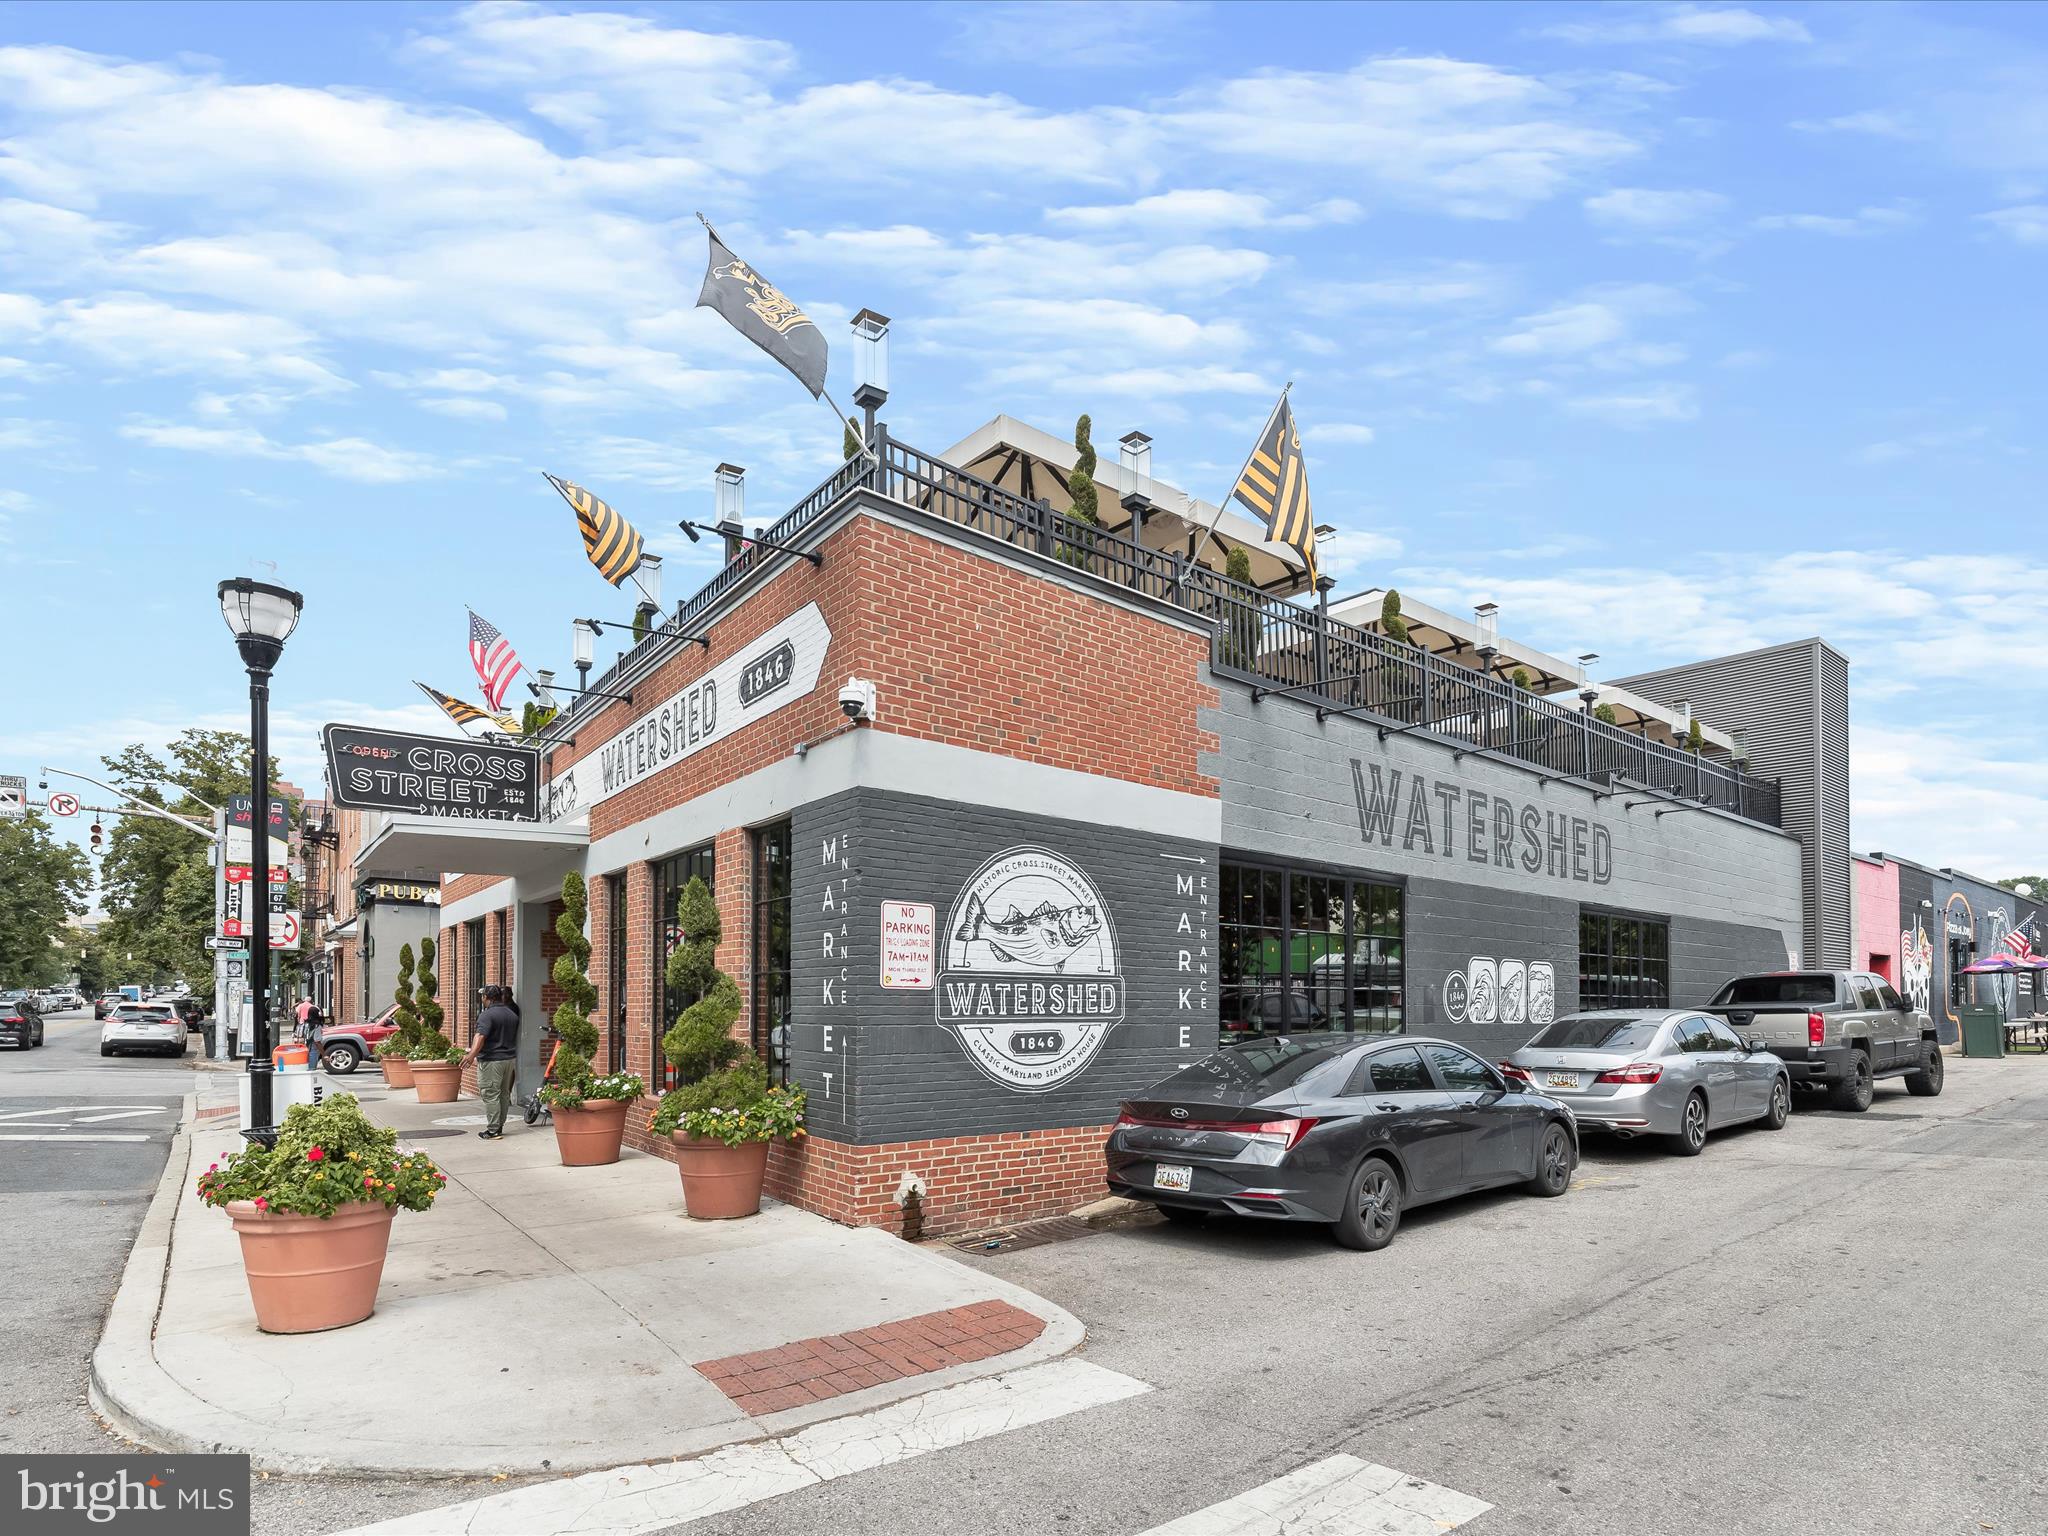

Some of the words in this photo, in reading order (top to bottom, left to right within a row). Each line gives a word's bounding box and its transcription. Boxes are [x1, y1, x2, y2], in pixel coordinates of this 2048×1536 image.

[748, 654, 784, 695] 1846
[601, 678, 717, 793] WATERSHED
[408, 746, 526, 782] CROSS
[350, 768, 493, 804] STREET
[503, 788, 525, 797] ESTD
[432, 805, 508, 819] MARKET
[1349, 758, 1612, 885] WATERSHED
[379, 883, 422, 900] PUB
[976, 864, 1011, 893] HISTORIC
[1012, 860, 1039, 870] CROSS
[1040, 860, 1067, 878] STREET
[1066, 874, 1094, 904] MARKET
[230, 889, 238, 913] LINK
[273, 894, 283, 902] 67
[901, 907, 915, 918] NO
[886, 921, 930, 935] PARKING
[919, 939, 930, 948] ZONE
[822, 837, 836, 1098] MARKET
[887, 950, 929, 962] 7AM-11AM
[1177, 873, 1193, 1069] MARKE
[946, 983, 1116, 1017] WATERSHED
[1449, 990, 1465, 1003] 1846
[1020, 1036, 1055, 1049] 1846
[973, 1039, 1000, 1068] CLASSIC
[1003, 1065, 1043, 1080] MARYLAND
[1046, 1056, 1077, 1078] SEAFOOD
[1077, 1033, 1097, 1058] HOUSE
